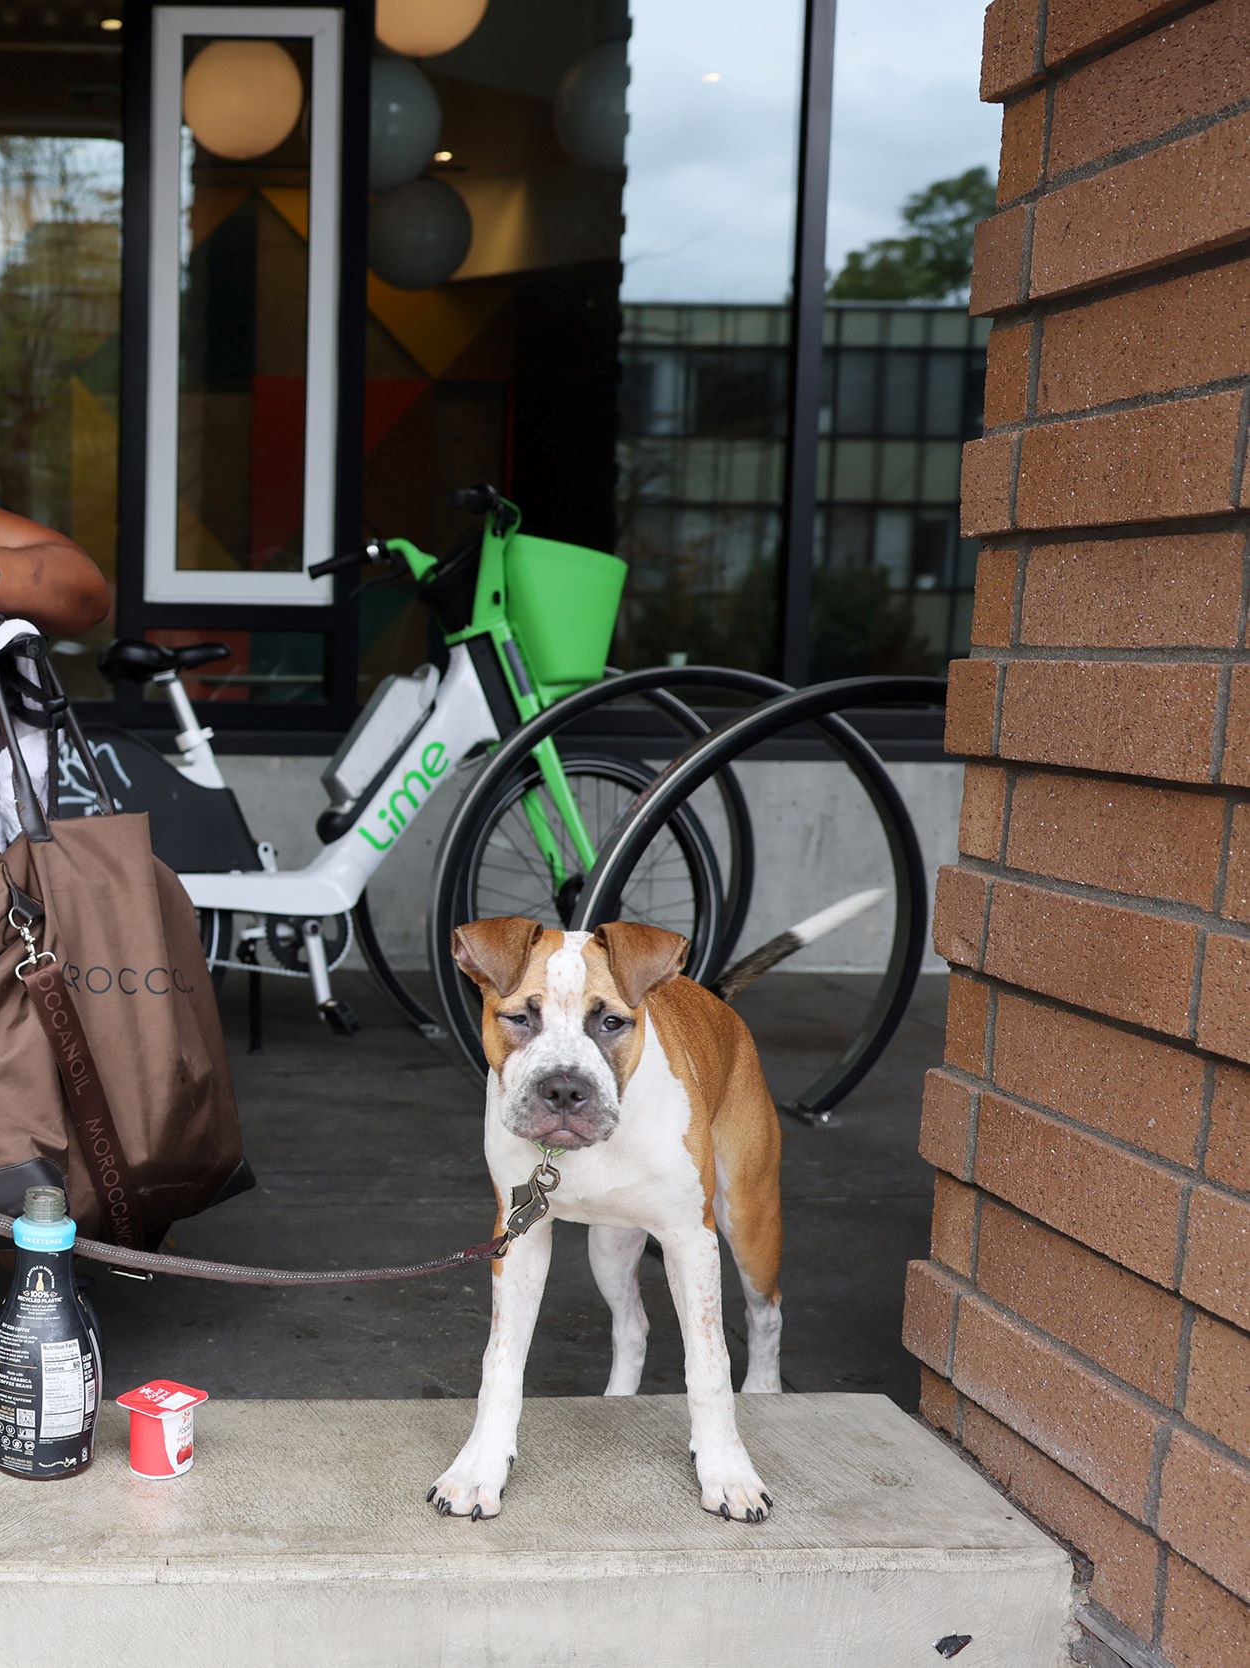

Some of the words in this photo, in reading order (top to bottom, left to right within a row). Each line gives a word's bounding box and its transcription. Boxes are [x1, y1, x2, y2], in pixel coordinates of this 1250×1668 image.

[357, 740, 450, 852] Lime
[17, 1294, 41, 1304] RECYCLED
[41, 1296, 64, 1304] PLASTIC
[30, 1290, 51, 1299] 100%
[73, 1360, 81, 1369] 60
[9, 1375, 33, 1384] ARABICA
[15, 1382, 33, 1390] BEANS
